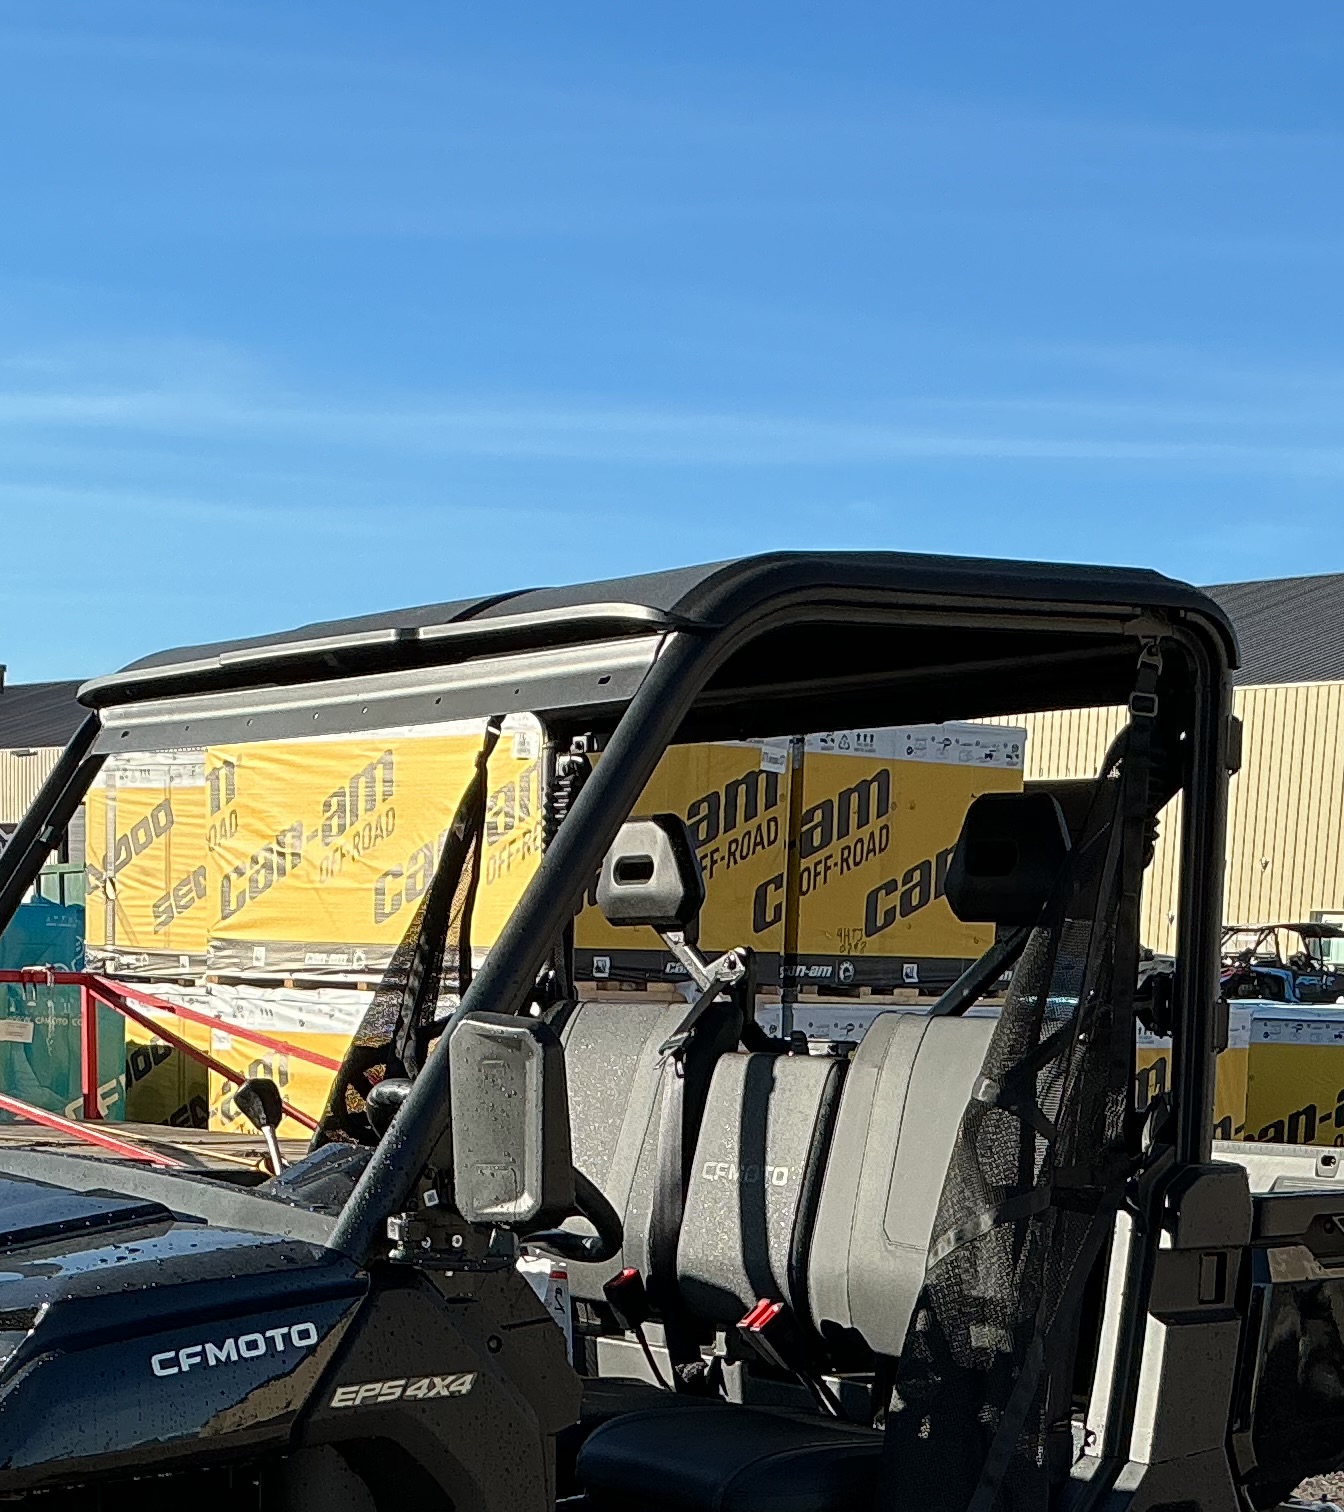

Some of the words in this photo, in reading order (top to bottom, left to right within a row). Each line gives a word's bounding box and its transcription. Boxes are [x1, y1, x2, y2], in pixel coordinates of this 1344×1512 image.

[799, 823, 890, 897] OFF-ROAD
[151, 1321, 318, 1377] CFMOTO
[329, 1379, 406, 1409] EPS
[404, 1372, 475, 1399] 4X4
